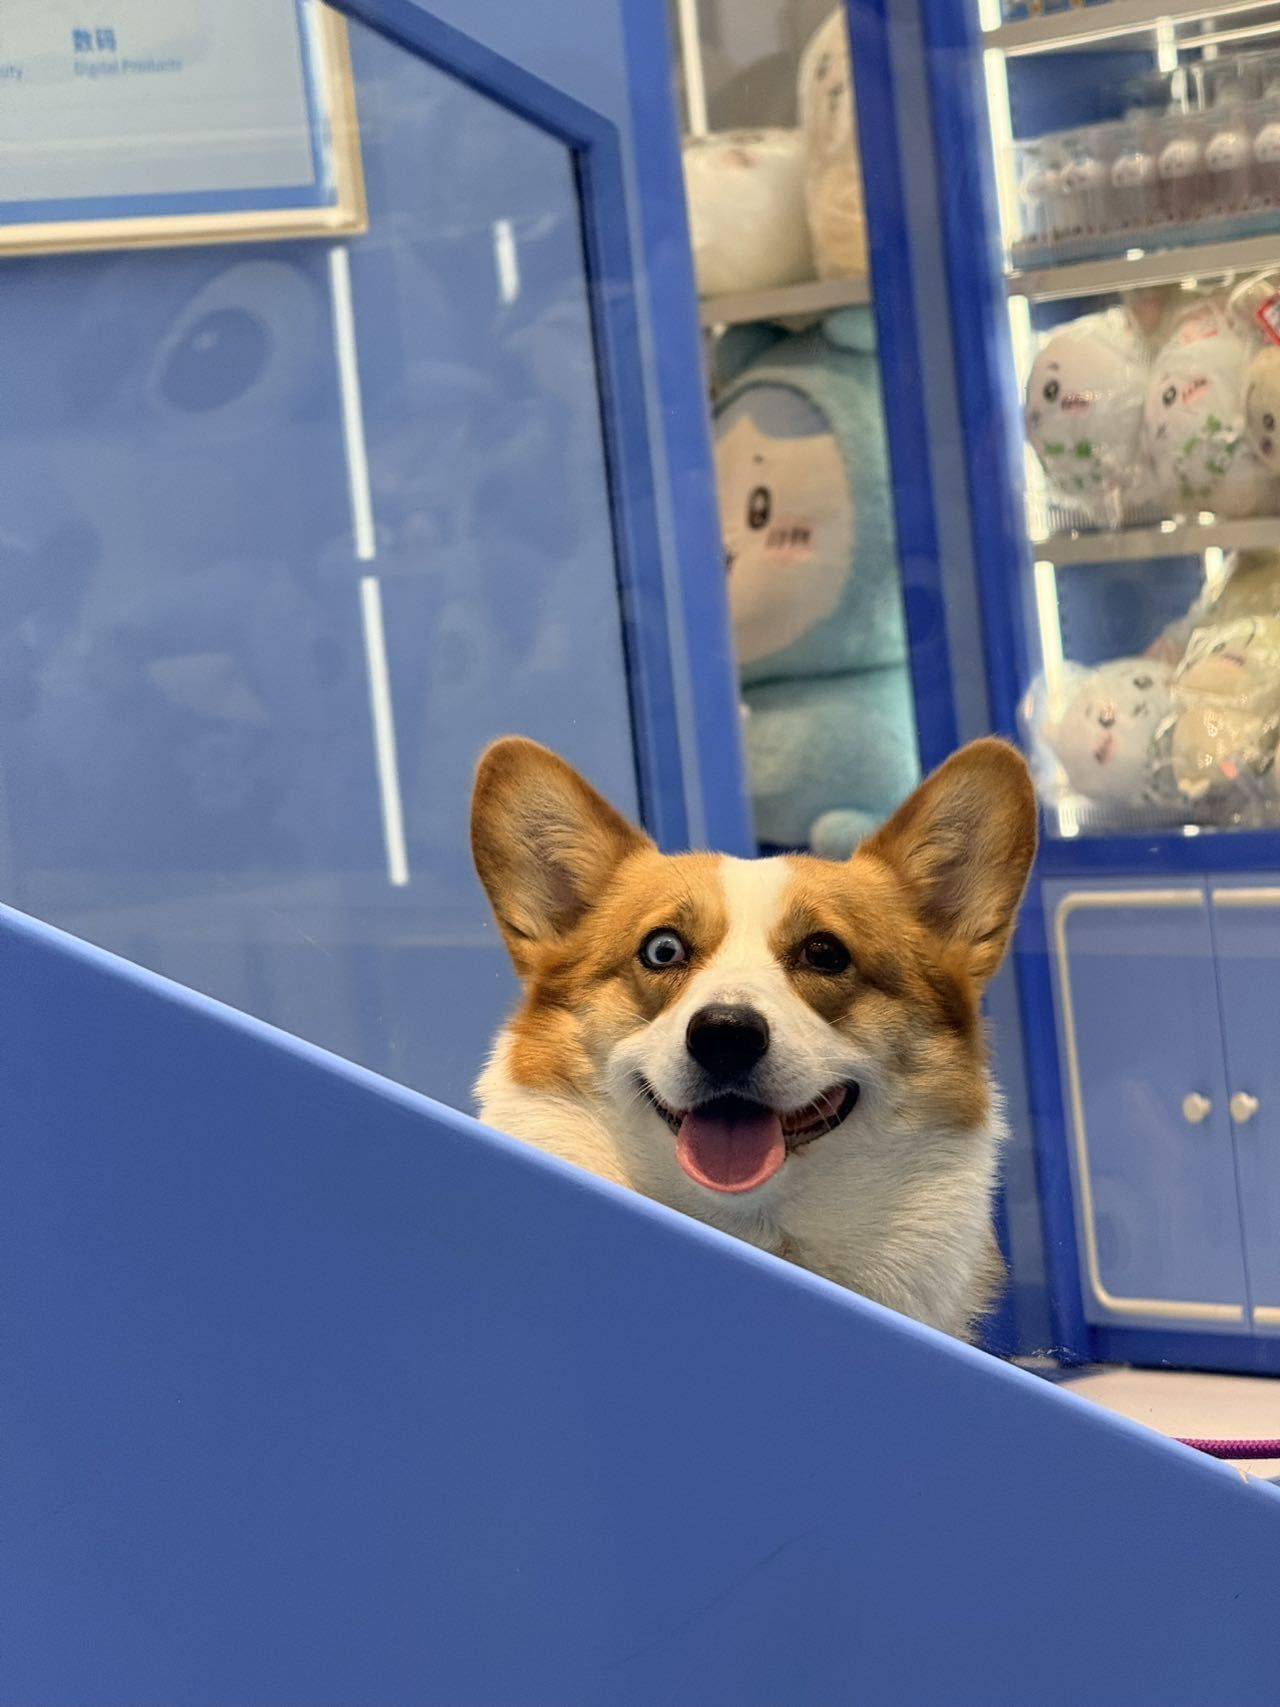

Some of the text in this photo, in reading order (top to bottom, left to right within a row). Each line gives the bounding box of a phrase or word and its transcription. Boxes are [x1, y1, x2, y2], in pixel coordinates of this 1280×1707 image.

[72, 28, 116, 52] 数码
[74, 58, 183, 77] Digital Products
